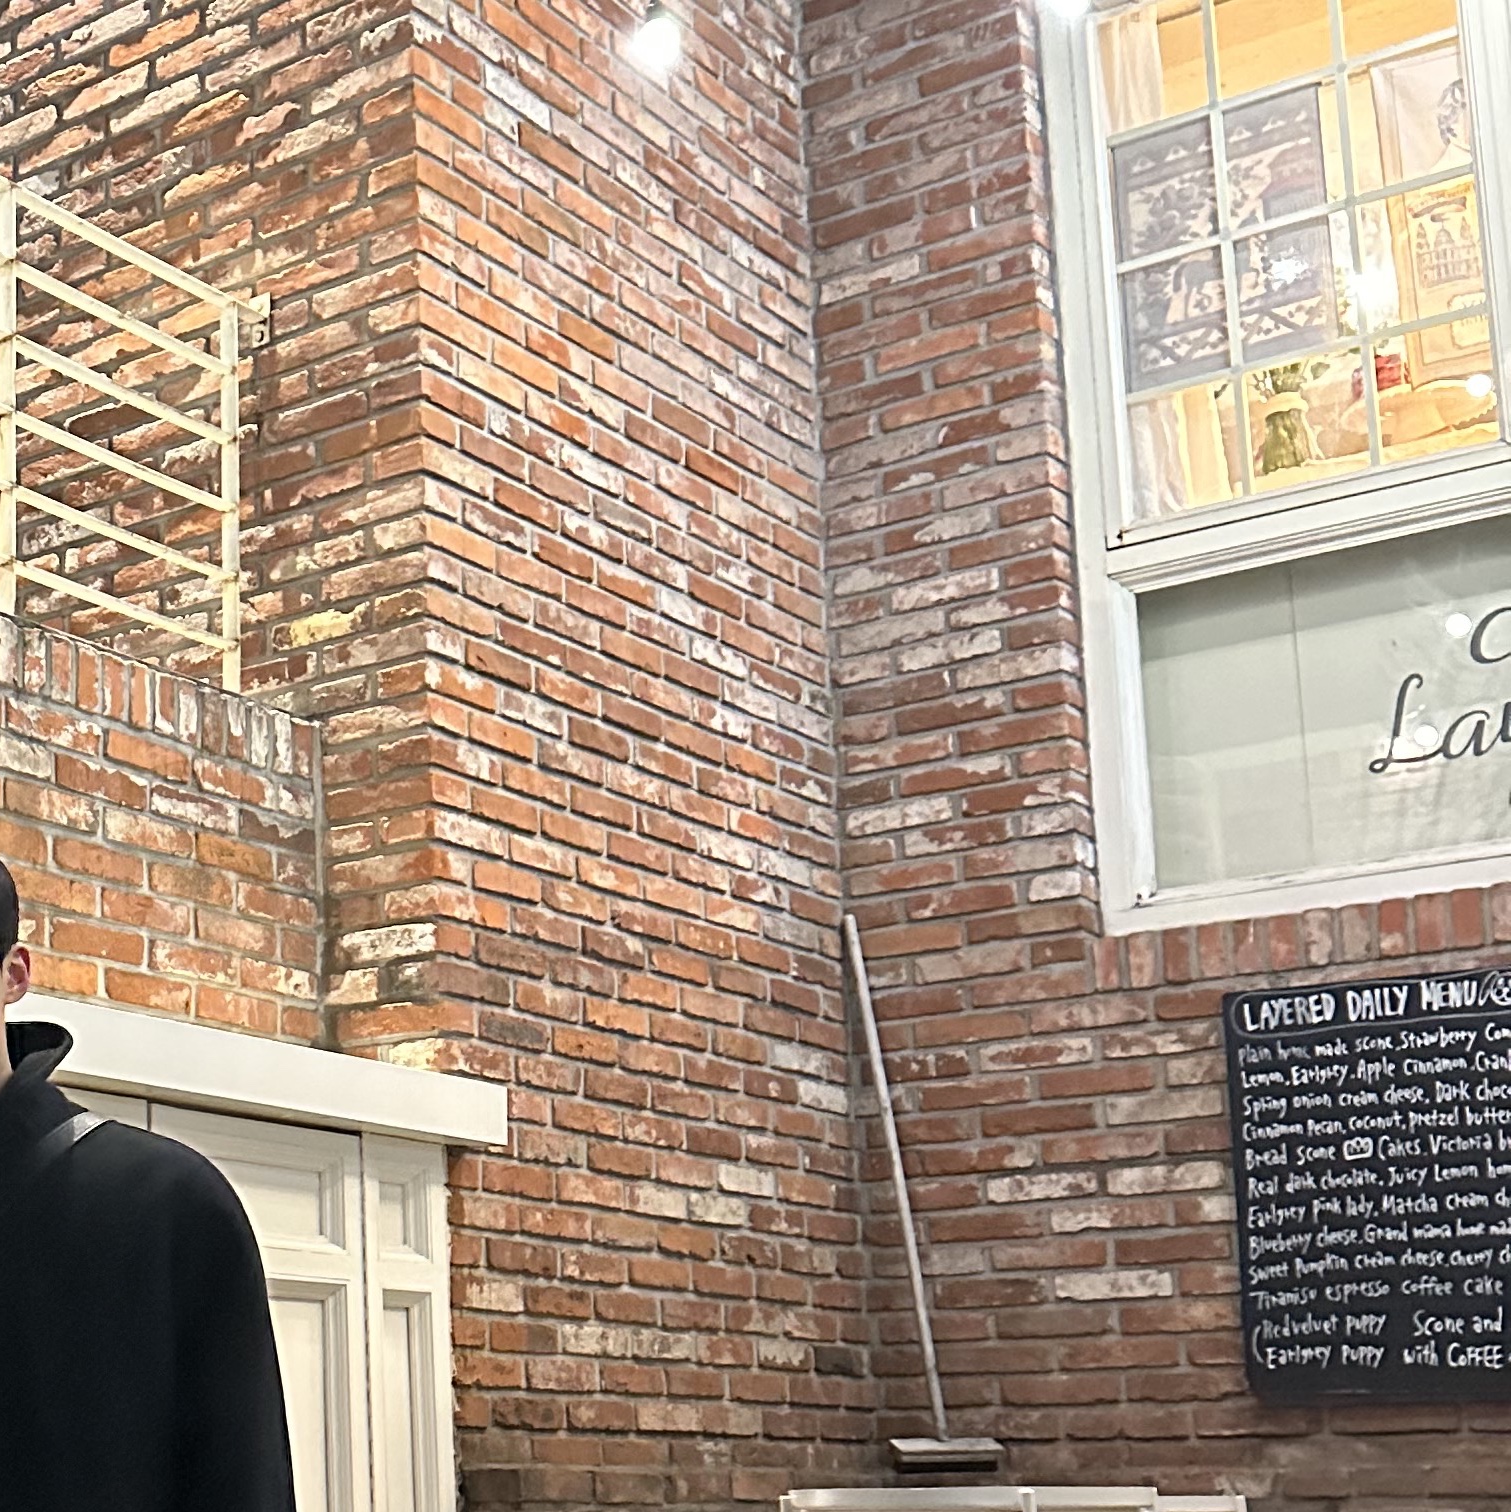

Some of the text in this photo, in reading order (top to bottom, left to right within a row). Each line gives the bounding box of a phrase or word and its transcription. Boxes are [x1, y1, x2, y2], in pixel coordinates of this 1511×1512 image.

[1243, 980, 1478, 1032] LAYERED DAILY MENU
[1314, 1037, 1349, 1057] made
[1357, 1056, 1395, 1084] Apple
[1243, 1095, 1287, 1121] Spring
[1293, 1092, 1332, 1108] onion
[1338, 1090, 1379, 1107] cream
[1325, 1280, 1391, 1304] espresso
[1401, 1275, 1453, 1296] coffee
[1413, 1309, 1465, 1337] Scone
[1472, 1305, 1504, 1334] and
[1403, 1340, 1439, 1367] with
